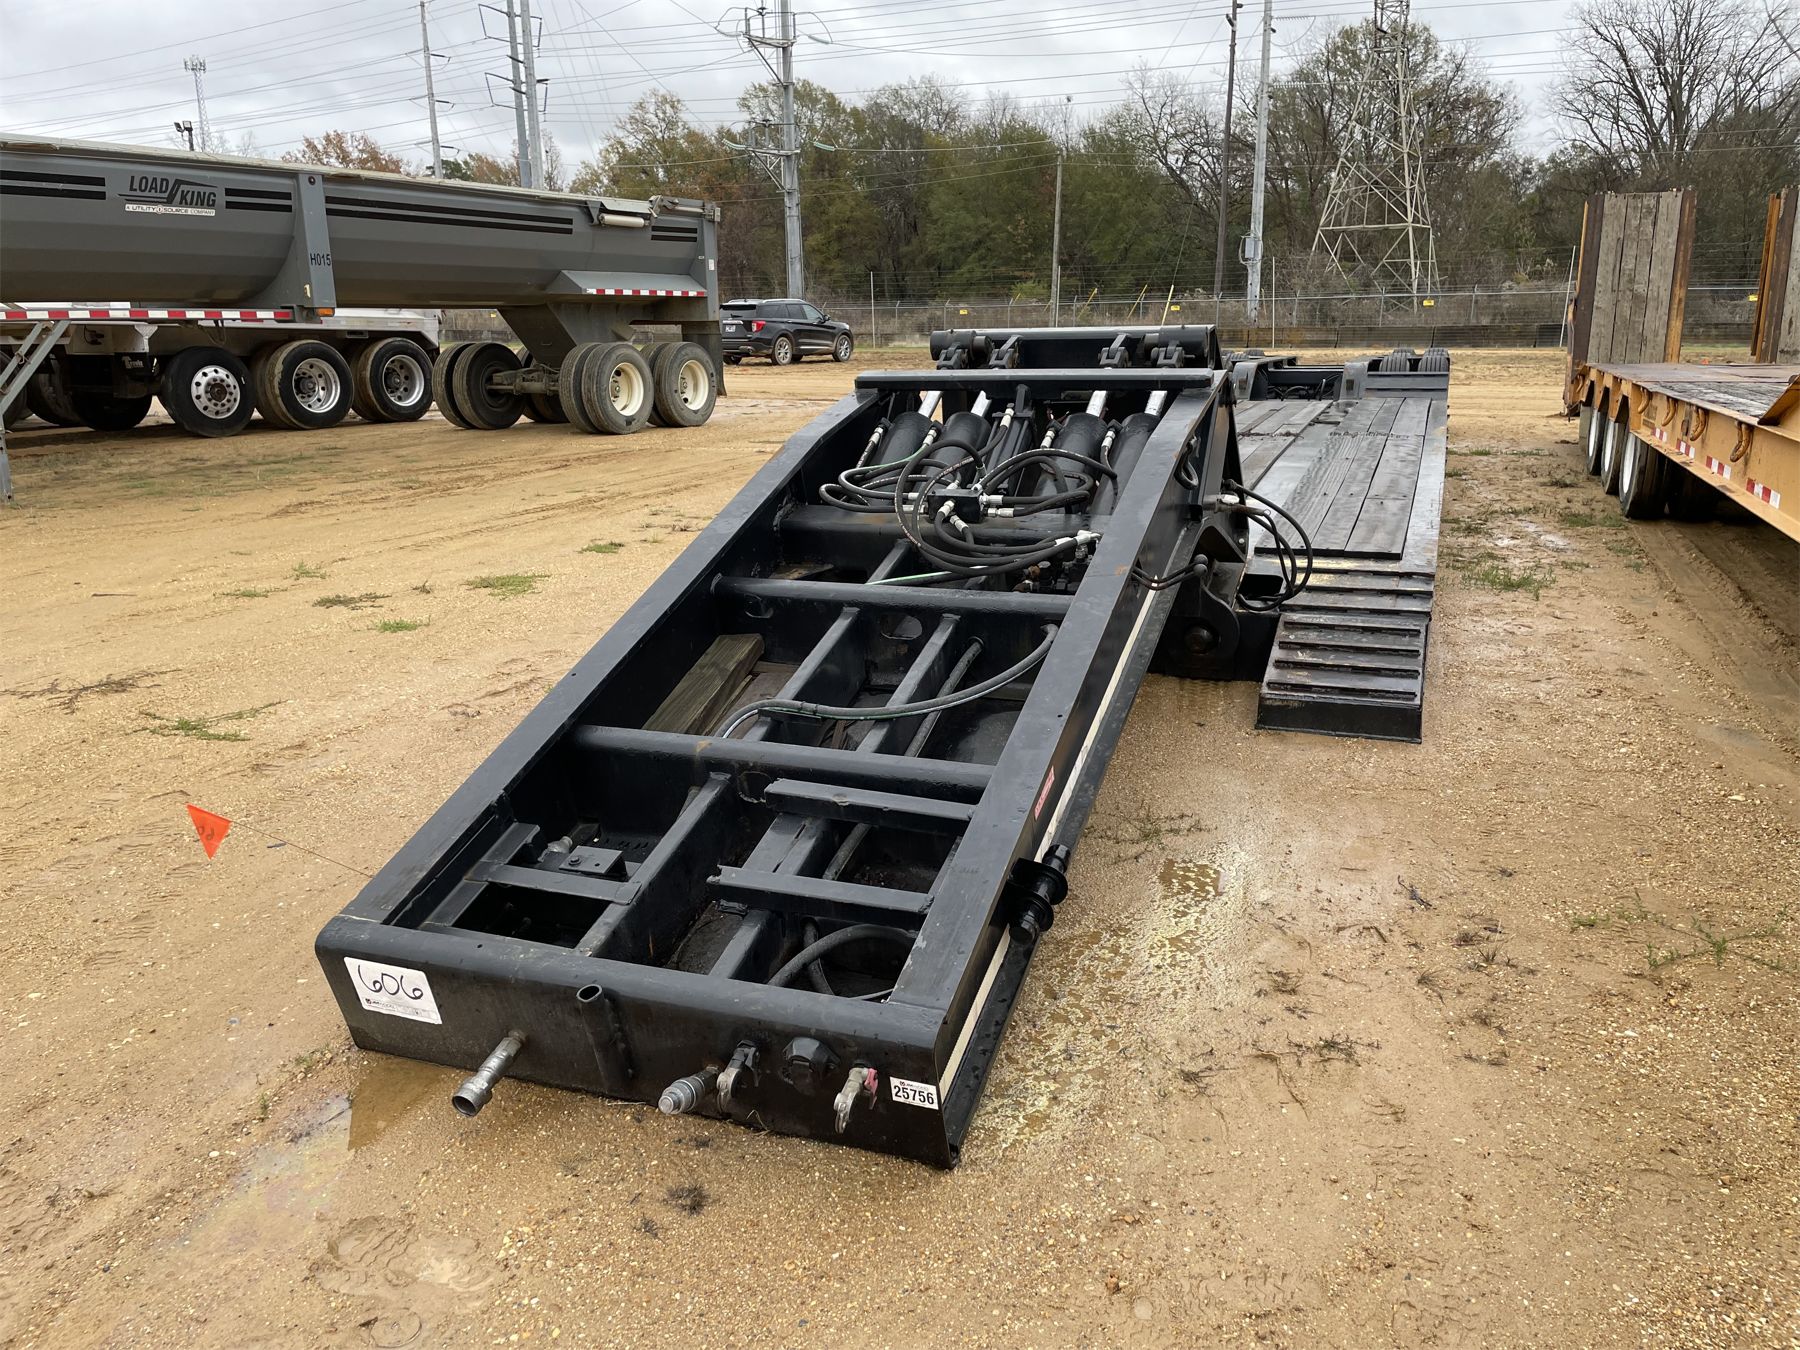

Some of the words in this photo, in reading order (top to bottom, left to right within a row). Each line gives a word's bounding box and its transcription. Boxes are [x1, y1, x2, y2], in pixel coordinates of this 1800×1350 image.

[129, 175, 170, 194] LOAD
[179, 189, 217, 208] KING
[309, 252, 331, 267] H015
[357, 964, 424, 1000] 606
[893, 1085, 934, 1105] 25756
